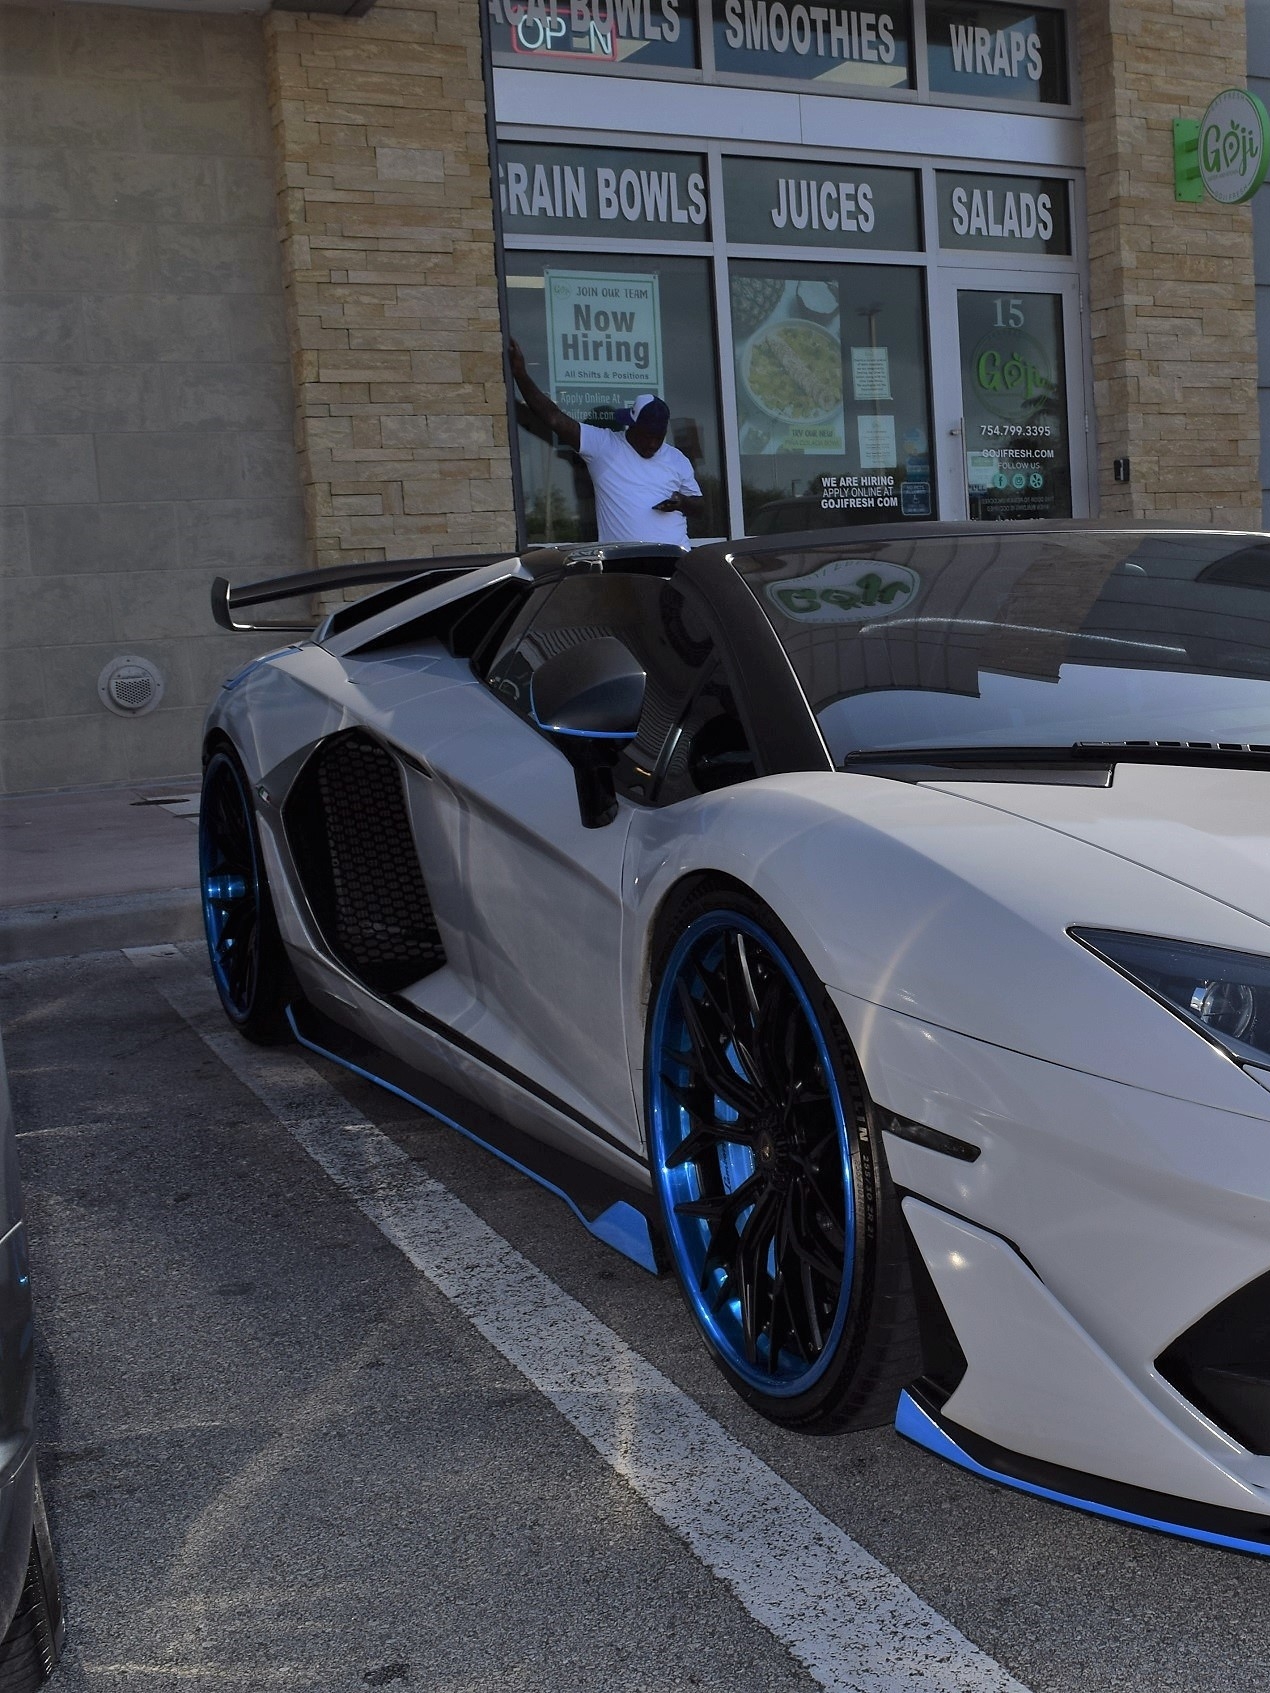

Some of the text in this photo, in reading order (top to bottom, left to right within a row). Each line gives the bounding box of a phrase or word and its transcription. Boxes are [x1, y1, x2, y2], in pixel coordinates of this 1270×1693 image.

[517, 14, 612, 54] OPN
[571, 0, 681, 42] BOWLS
[725, 0, 895, 63] SMOOTHIES
[950, 23, 1043, 81] WRAPS
[1203, 119, 1258, 176] Goji
[597, 167, 707, 226] BOWLS
[771, 178, 876, 233] JUICES
[952, 186, 1053, 240] SALADS
[576, 286, 648, 299] JOIN OUR TEAM
[573, 303, 636, 333] Now
[992, 297, 1025, 328] 15
[562, 333, 650, 369] Hiring
[564, 370, 649, 380] All Shifts & Positions
[560, 391, 621, 404] Apply Online At
[980, 425, 1051, 437] 754.799.3395
[982, 449, 1054, 458] GOJIFRESH.COM
[998, 462, 1029, 470] FOLLOW
[821, 475, 894, 487] WE ARE HIRING
[822, 486, 894, 498] APPLY ONLINE AT
